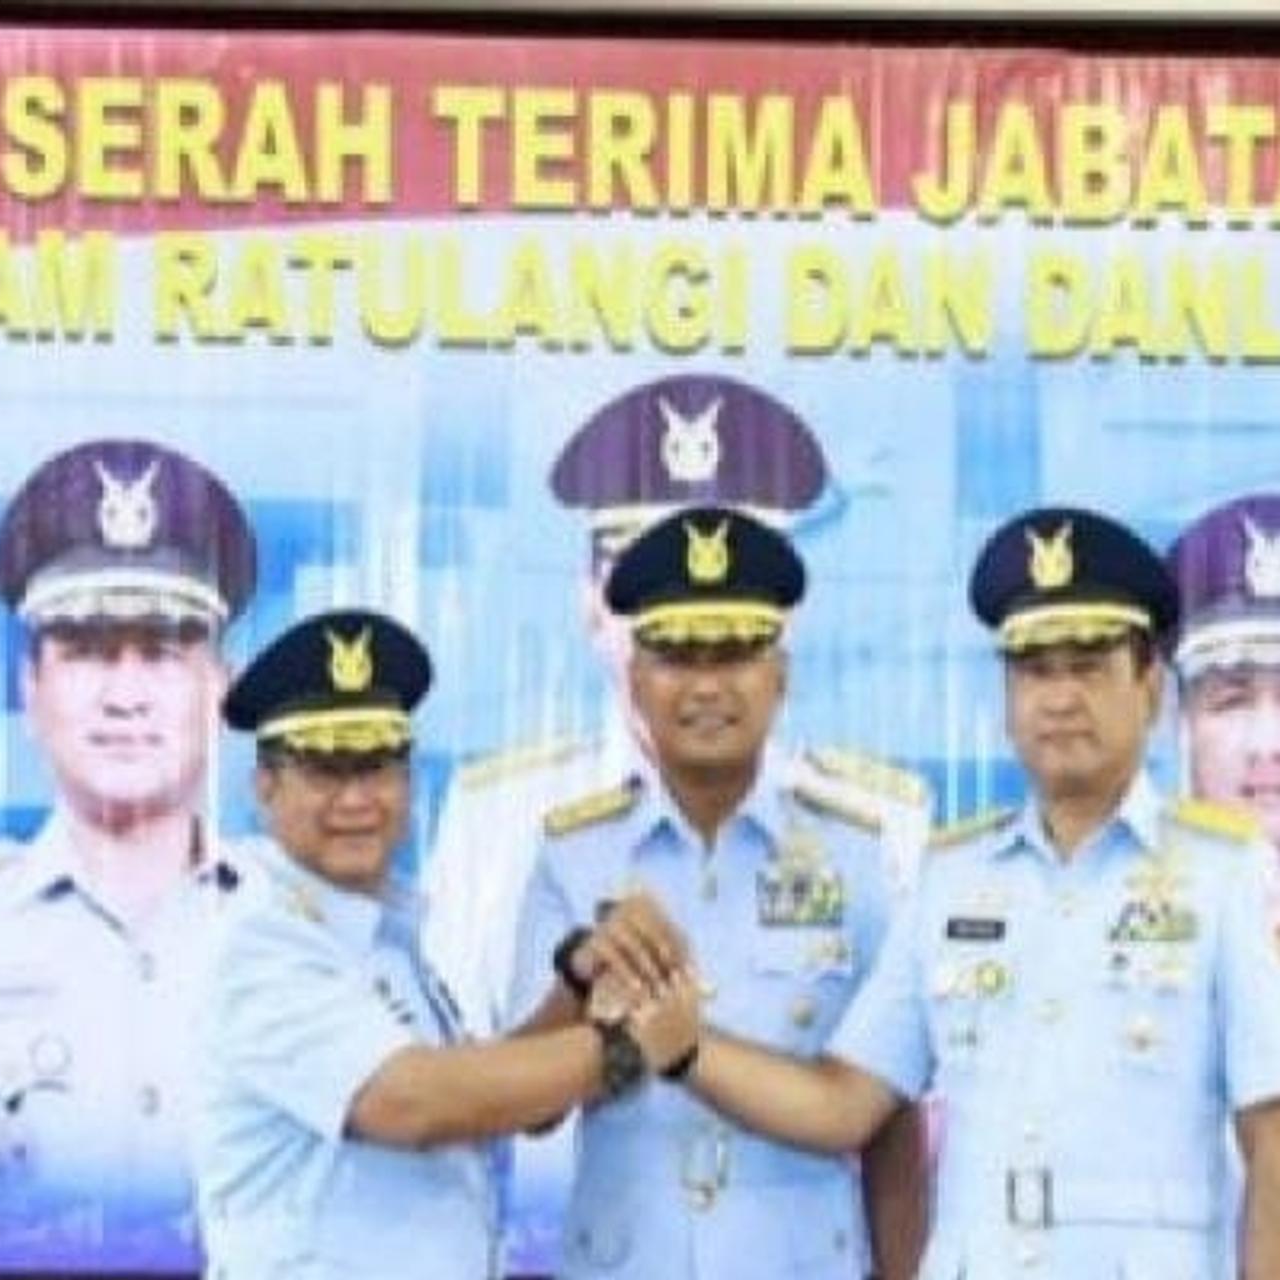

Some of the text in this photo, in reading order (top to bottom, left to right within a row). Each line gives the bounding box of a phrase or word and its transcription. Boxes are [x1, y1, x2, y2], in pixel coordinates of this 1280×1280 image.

[434, 84, 876, 218] TERIMA
[150, 229, 748, 356] RATULANGI
[784, 245, 992, 360] DAN
